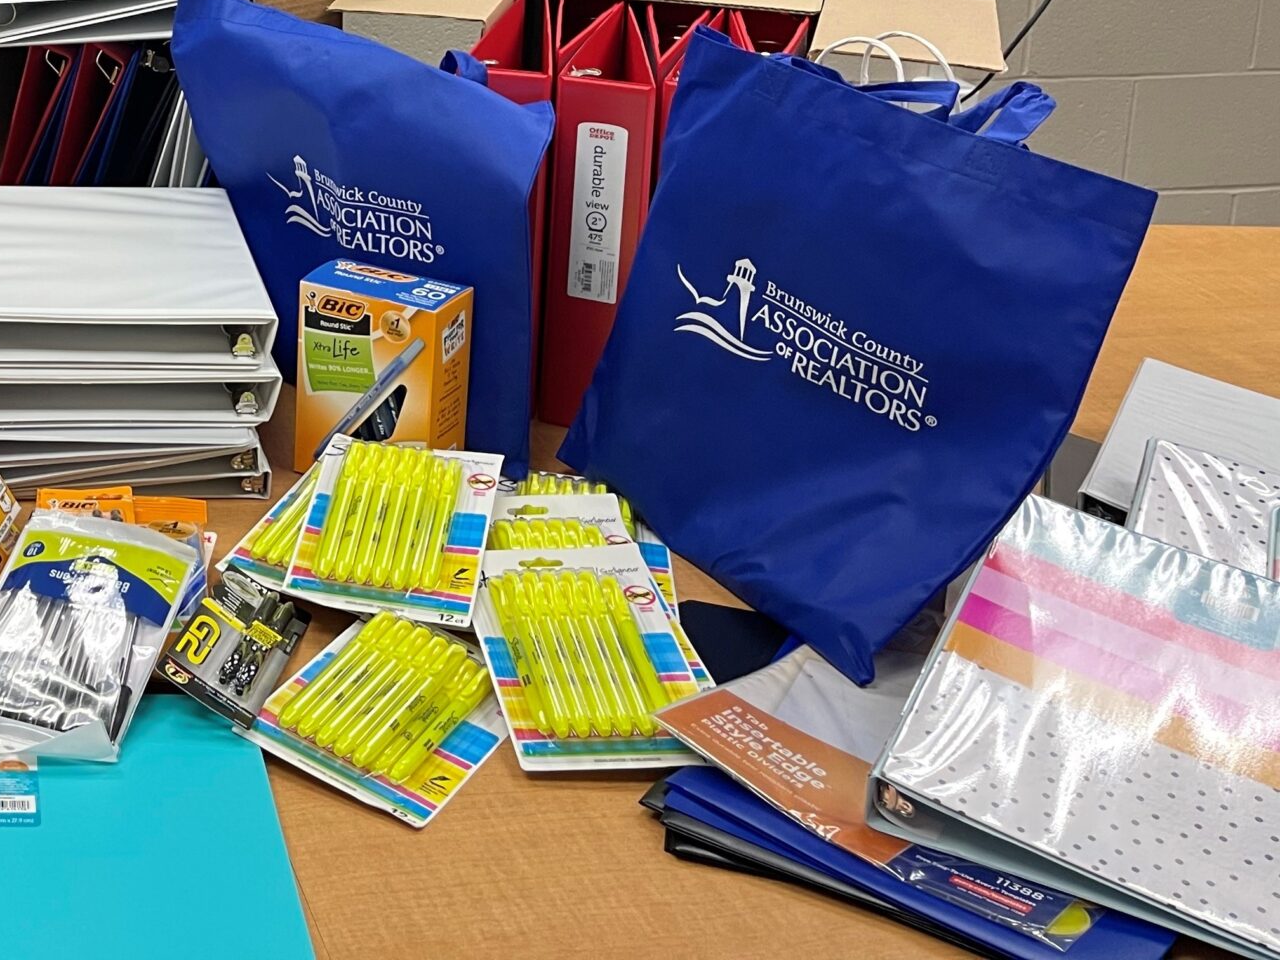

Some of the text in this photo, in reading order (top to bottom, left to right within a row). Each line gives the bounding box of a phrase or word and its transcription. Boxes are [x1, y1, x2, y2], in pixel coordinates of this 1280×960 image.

[589, 127, 615, 136] Office
[314, 168, 422, 215] Brunswick County
[591, 145, 606, 198] durable
[317, 188, 433, 241] ASSOCIATION
[585, 200, 609, 211] view
[412, 287, 446, 301] 60
[320, 320, 339, 330] Round
[766, 281, 924, 375] Brunswick County
[313, 337, 360, 361] Xtra Life
[751, 304, 927, 408] ASSOCIATION
[775, 341, 793, 360] OF
[176, 614, 221, 665] G2
[437, 613, 454, 623] 12
[721, 709, 828, 778] Insertable
[745, 713, 769, 731] Tab
[701, 718, 746, 751] Plastic
[746, 750, 806, 790] Dividers
[710, 714, 764, 751] Style
[767, 752, 826, 790] Edge
